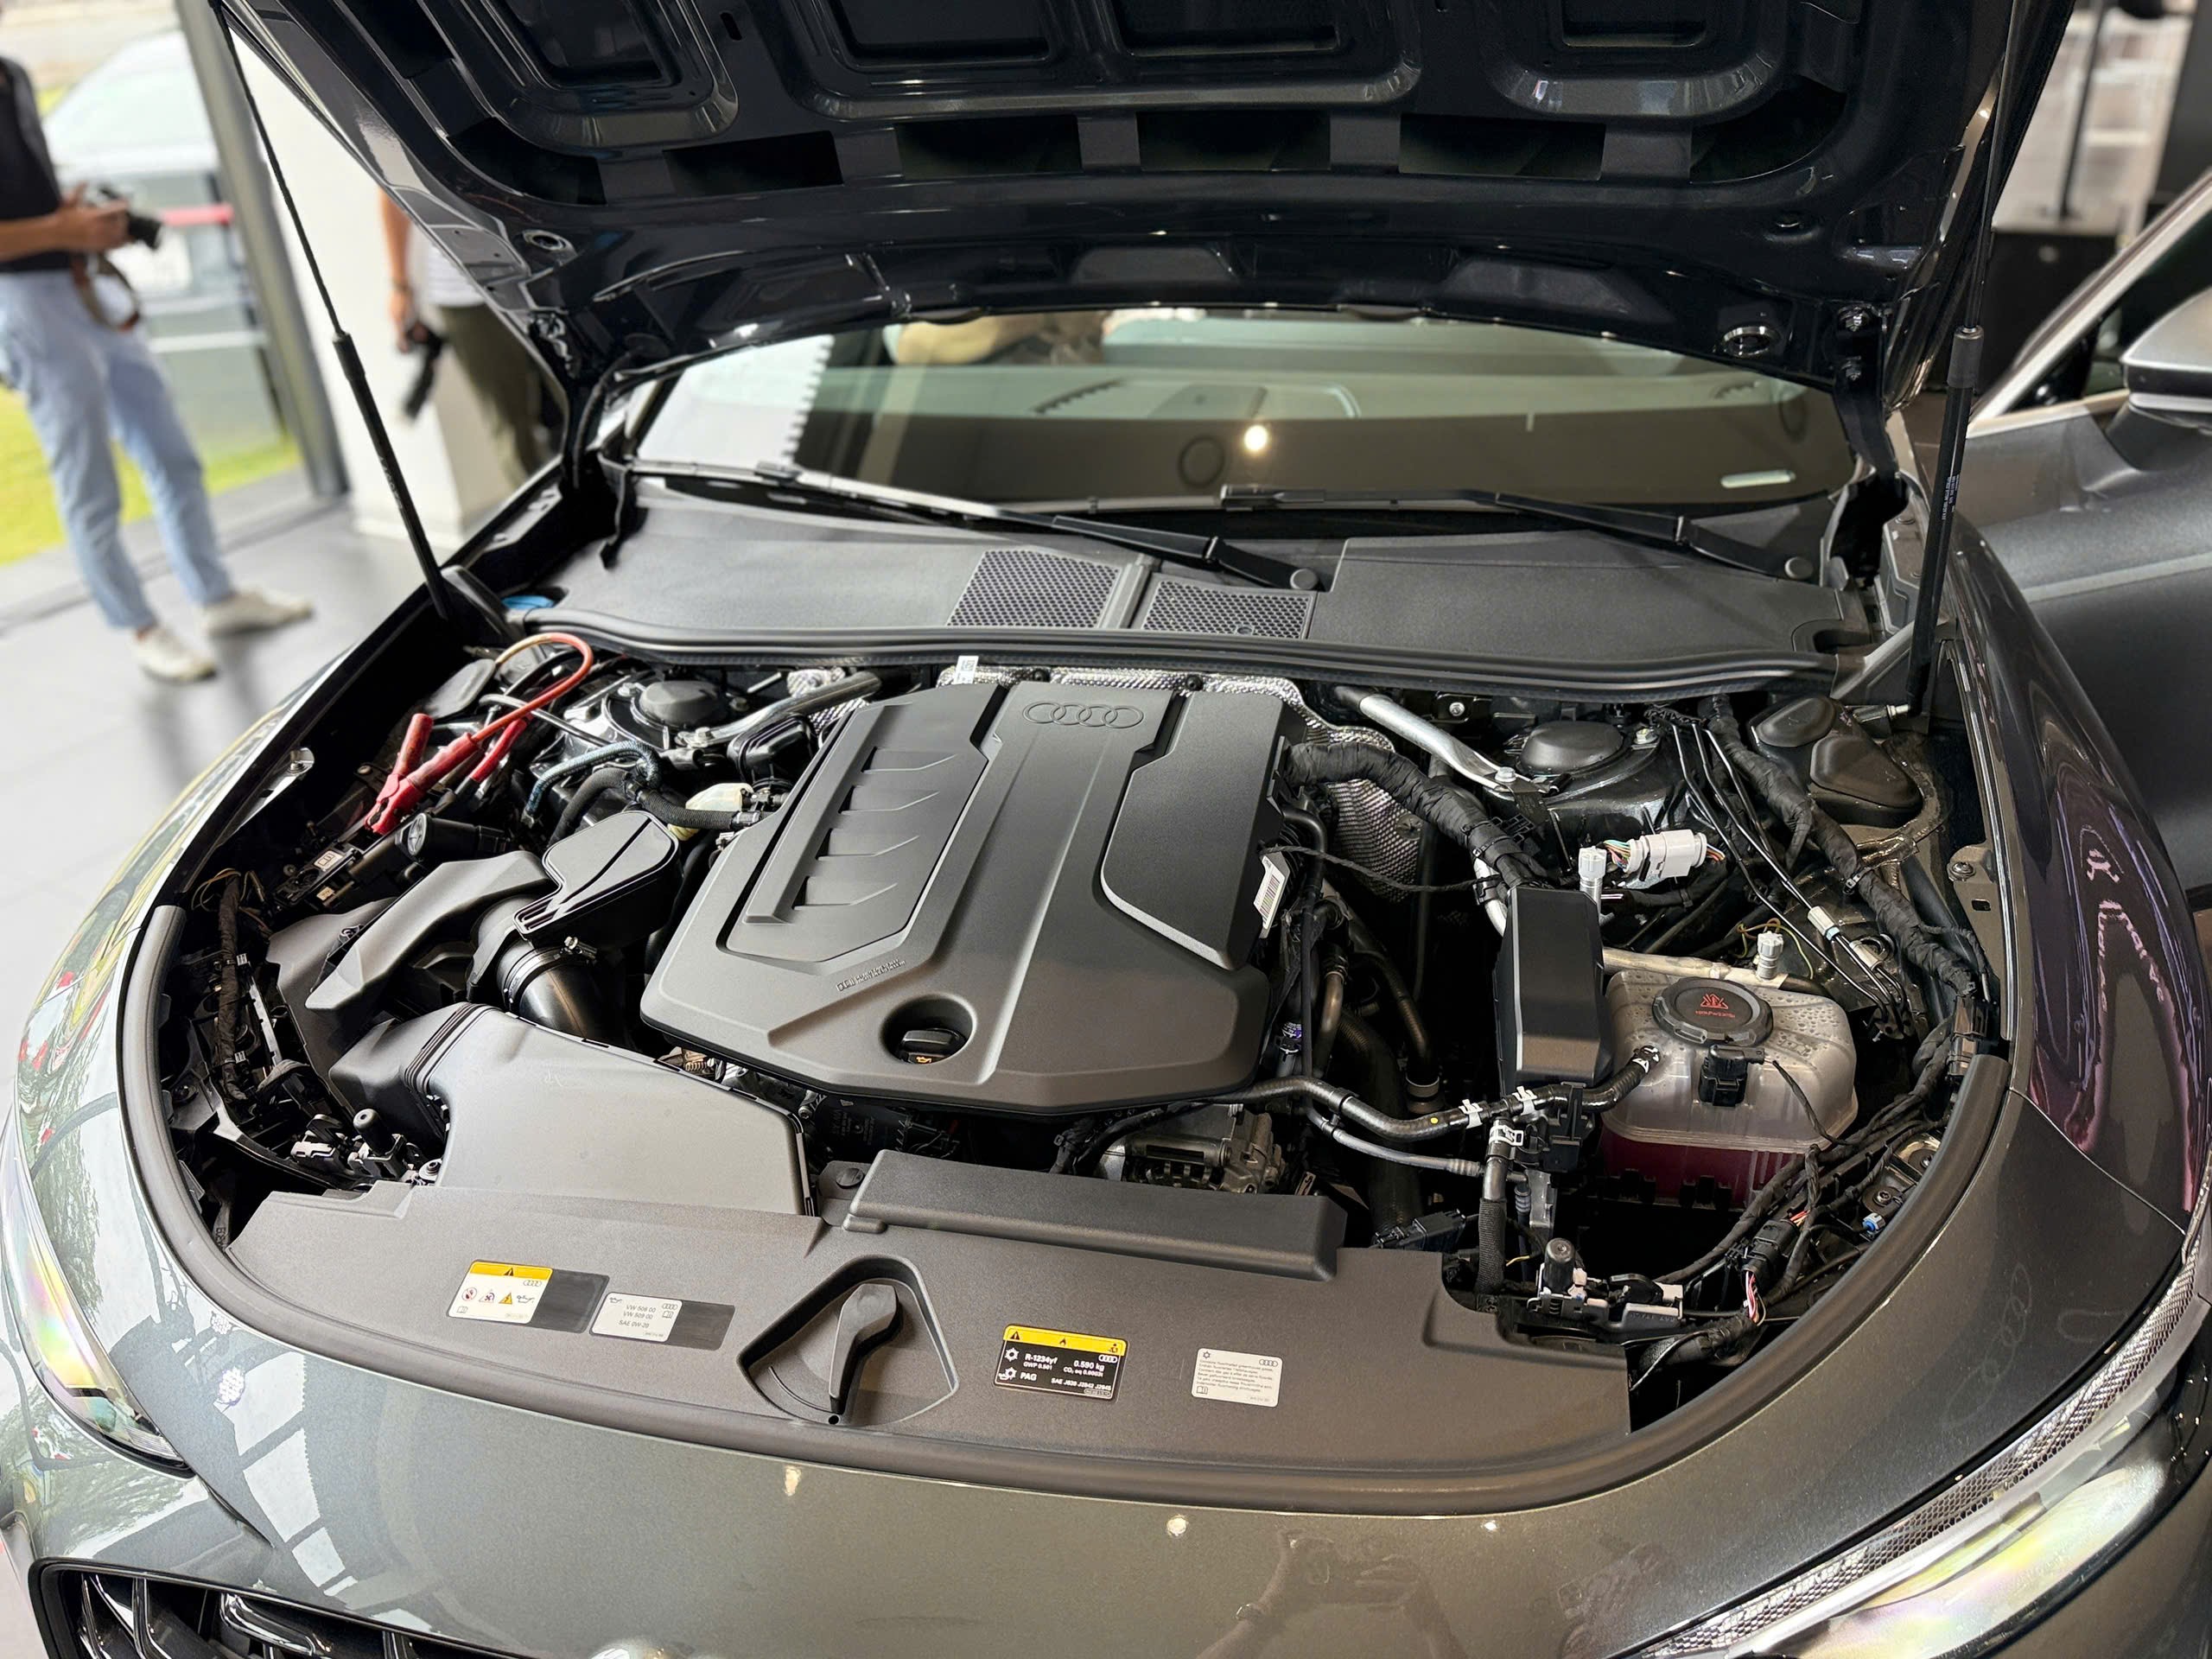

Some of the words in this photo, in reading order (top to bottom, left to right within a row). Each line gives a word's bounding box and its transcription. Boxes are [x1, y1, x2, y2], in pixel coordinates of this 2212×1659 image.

[1025, 1353, 1058, 1363] R-1234yf
[1073, 1360, 1095, 1369] 0.590
[1095, 1362, 1105, 1371] kg
[1020, 1372, 1038, 1381] PAG
